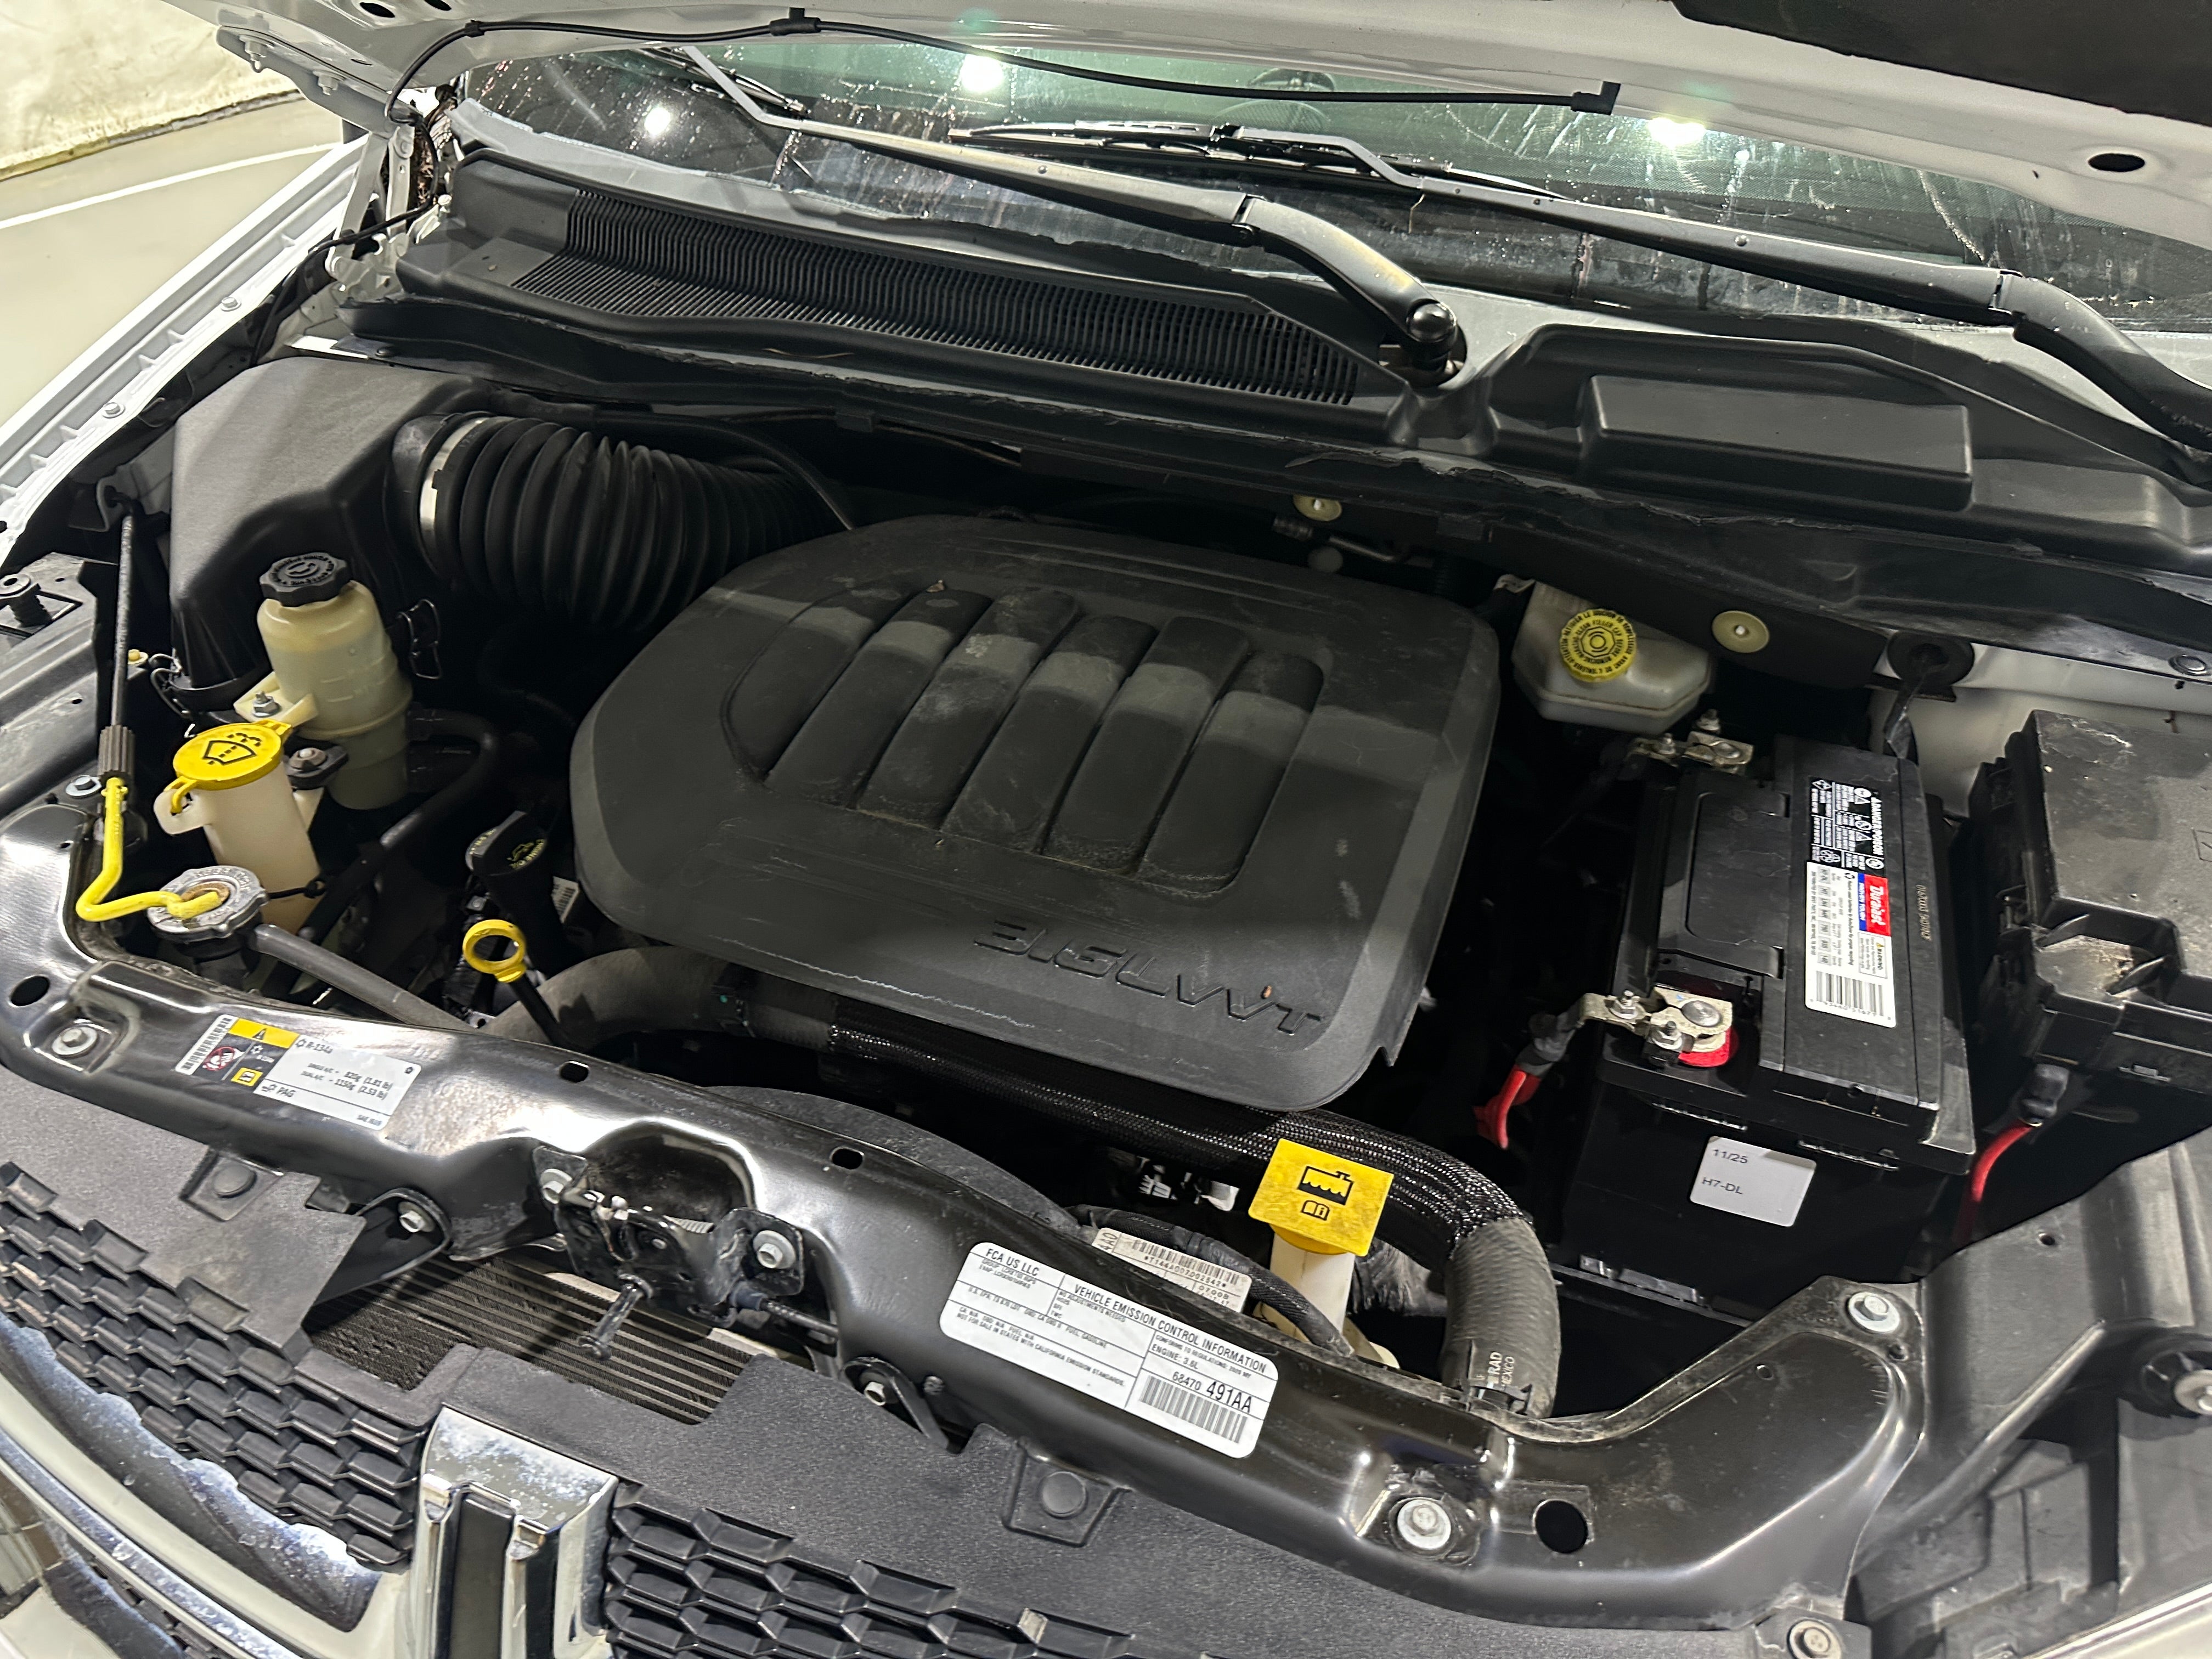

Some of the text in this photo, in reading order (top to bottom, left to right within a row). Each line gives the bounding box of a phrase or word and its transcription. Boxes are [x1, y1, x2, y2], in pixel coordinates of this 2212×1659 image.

[1870, 802, 1884, 856] DANGER/POISON
[275, 1086, 296, 1098] PAG
[1712, 1149, 1748, 1164] 11/25
[1701, 1177, 1743, 1195] H7-DL
[985, 1247, 1005, 1263] FCA
[1005, 1255, 1020, 1269] US
[1020, 1262, 1040, 1277] LLC
[1073, 1283, 1267, 1374] VEHICLE EMISSION CONTROL INFORMATION
[1150, 1344, 1200, 1370] ENGINE: 3.6L
[1487, 1351, 1502, 1375] RAD
[1171, 1370, 1256, 1414] 68470 491AA
